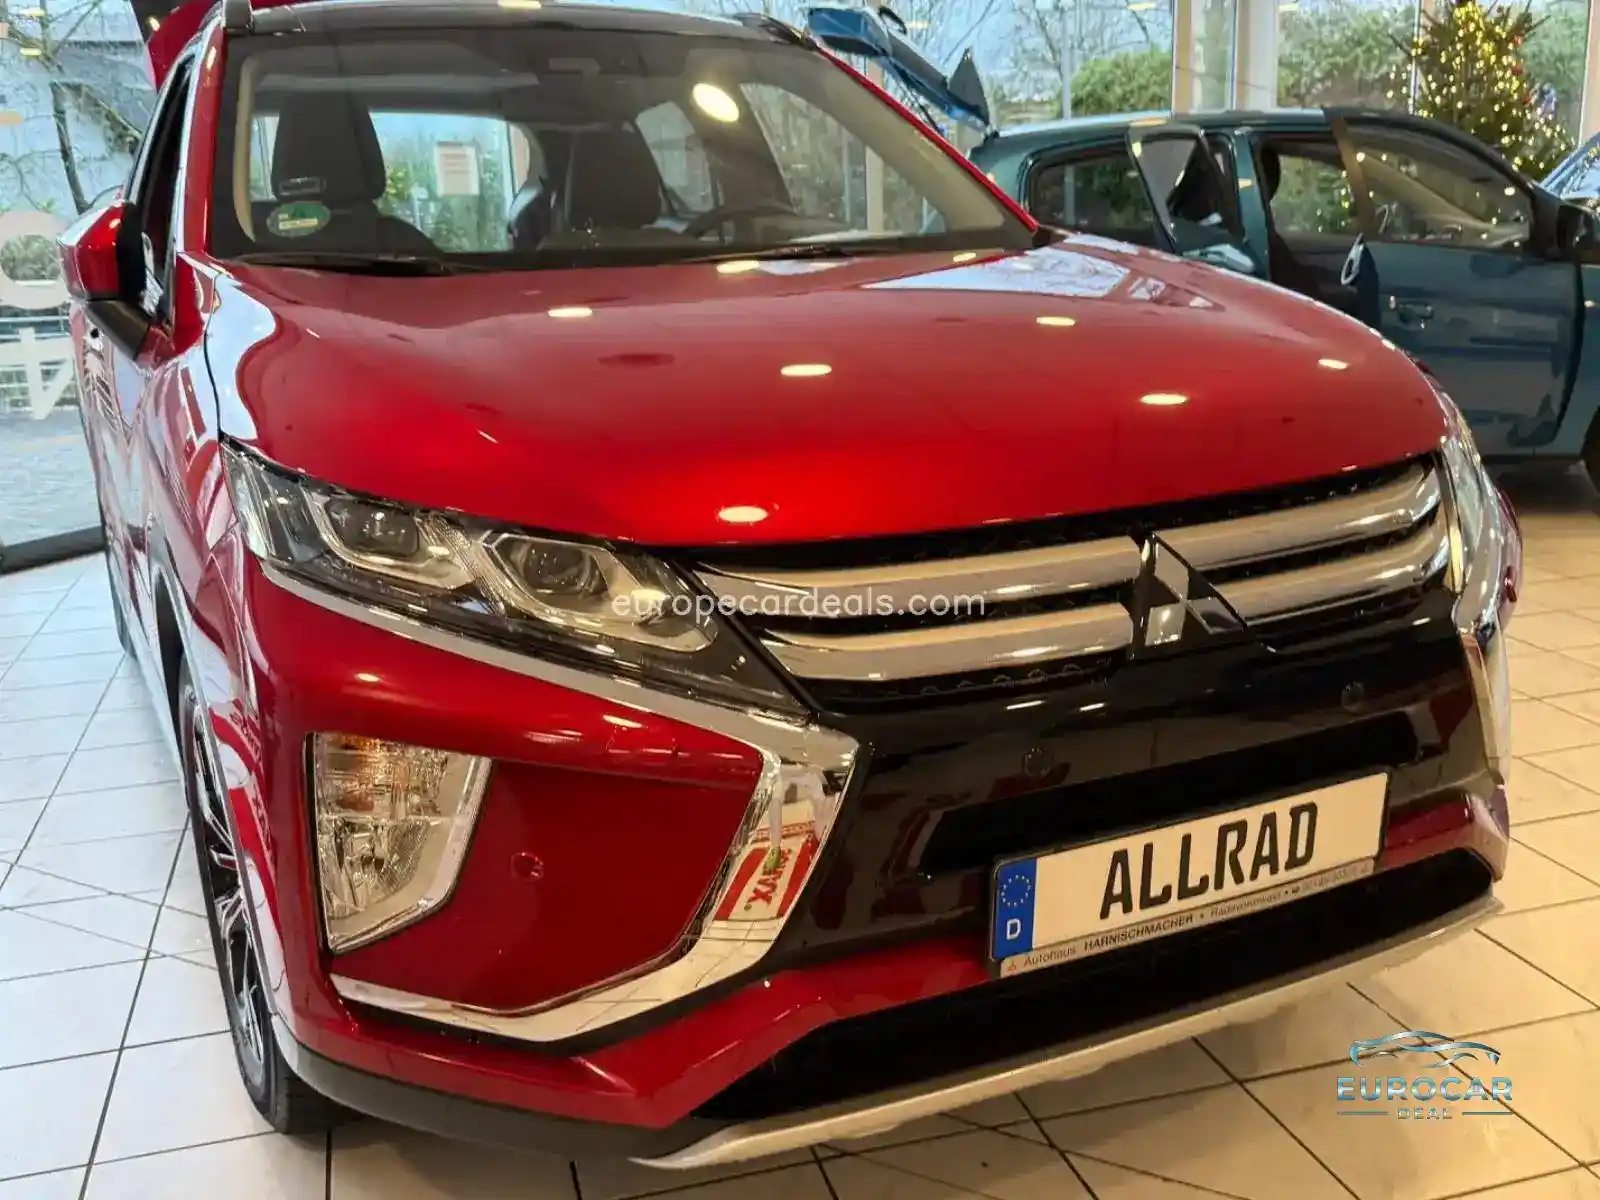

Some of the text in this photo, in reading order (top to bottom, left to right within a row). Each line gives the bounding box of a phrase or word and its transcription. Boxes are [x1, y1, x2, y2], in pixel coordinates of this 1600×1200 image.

[1099, 801, 1318, 920] ALLRAD
[1006, 917, 1022, 940] D
[1023, 944, 1077, 967] Autohaus
[1084, 915, 1194, 951] HARNISCHMACHER
